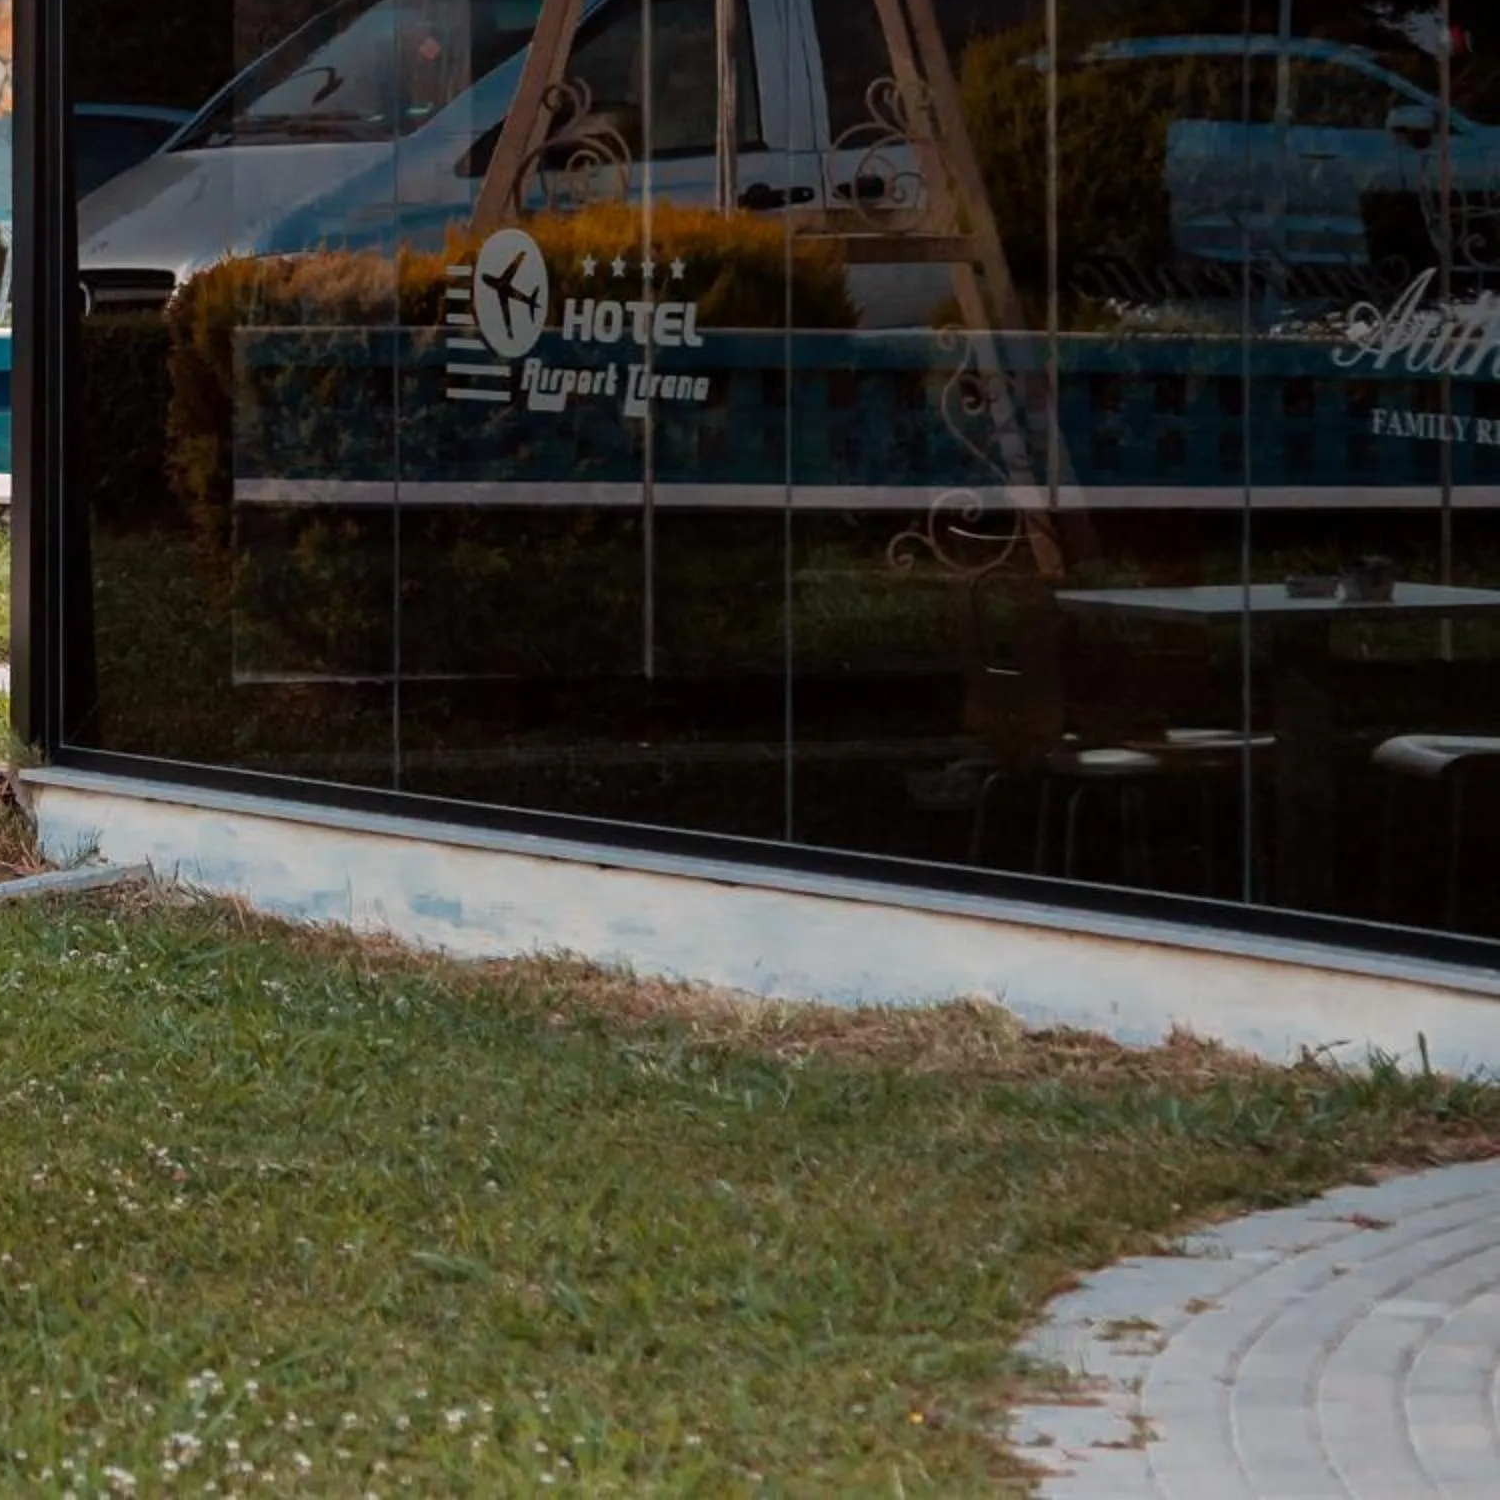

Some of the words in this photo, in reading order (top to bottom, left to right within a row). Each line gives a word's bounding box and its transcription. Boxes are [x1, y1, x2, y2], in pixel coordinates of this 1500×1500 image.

[562, 297, 705, 348] HOTEL
[520, 356, 620, 412] Airport
[623, 362, 712, 418] Tirana
[1371, 407, 1471, 443] FAMILY
